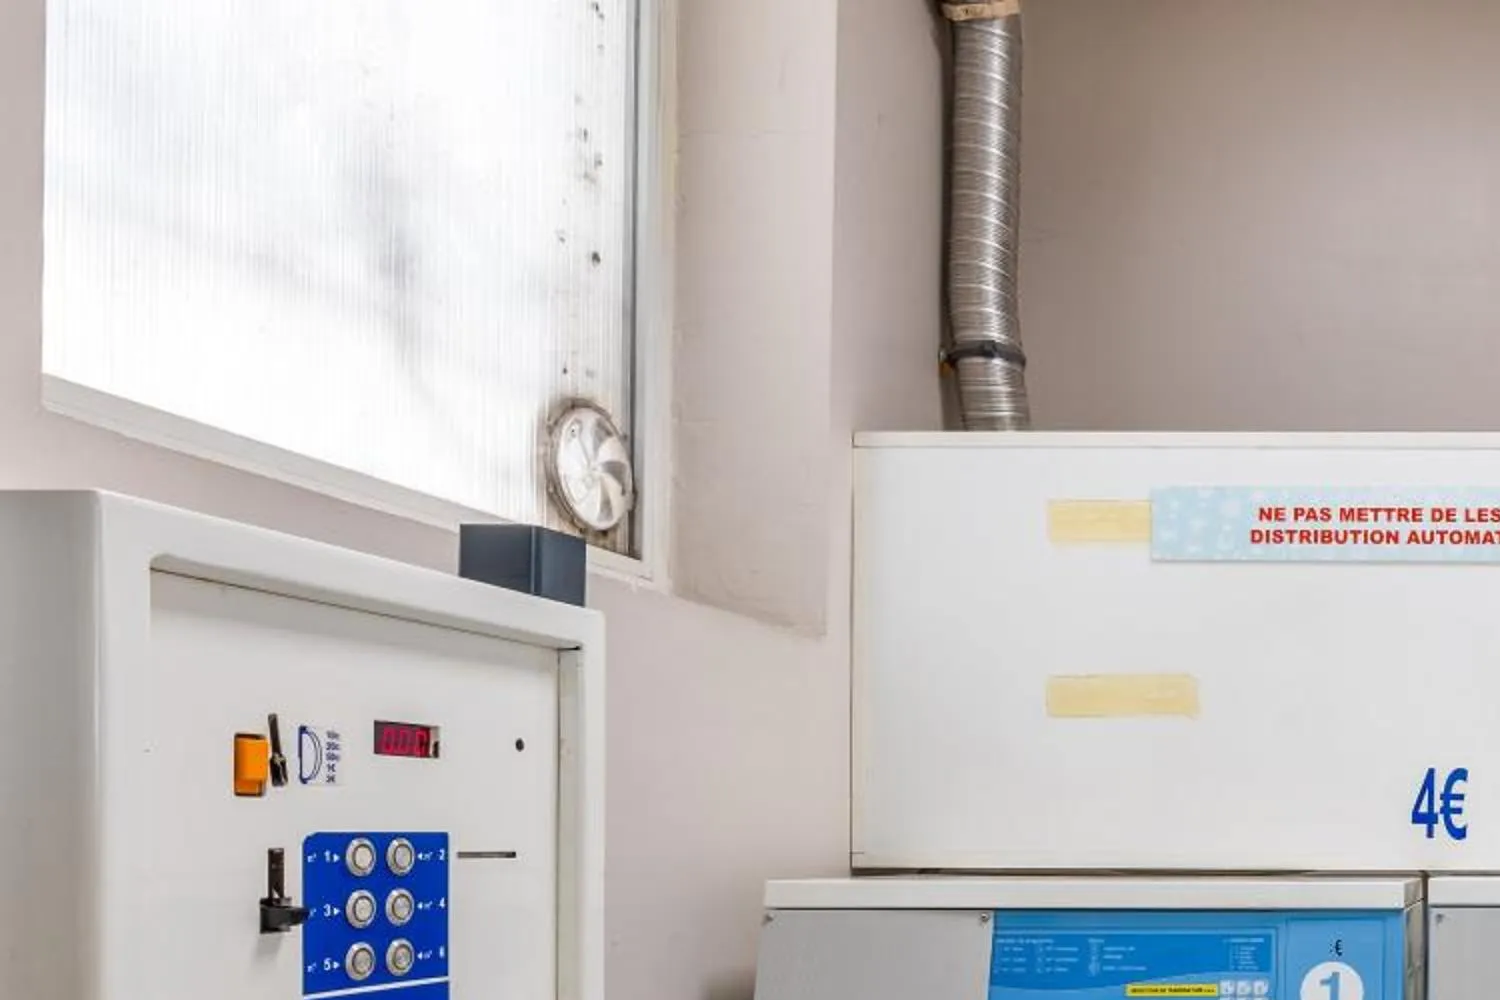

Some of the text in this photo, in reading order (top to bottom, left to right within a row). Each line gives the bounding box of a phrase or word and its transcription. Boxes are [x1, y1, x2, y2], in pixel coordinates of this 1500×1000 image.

[1258, 507, 1287, 522] NE
[1293, 507, 1333, 522] PAS
[1339, 507, 1423, 523] METTRE
[1431, 507, 1457, 523] DE
[1250, 529, 1401, 544] DISTRIBUTION
[1411, 767, 1468, 840] 4€
[439, 848, 446, 861] 2
[439, 897, 446, 908] 4
[323, 904, 331, 917] 3
[323, 957, 331, 971] 5
